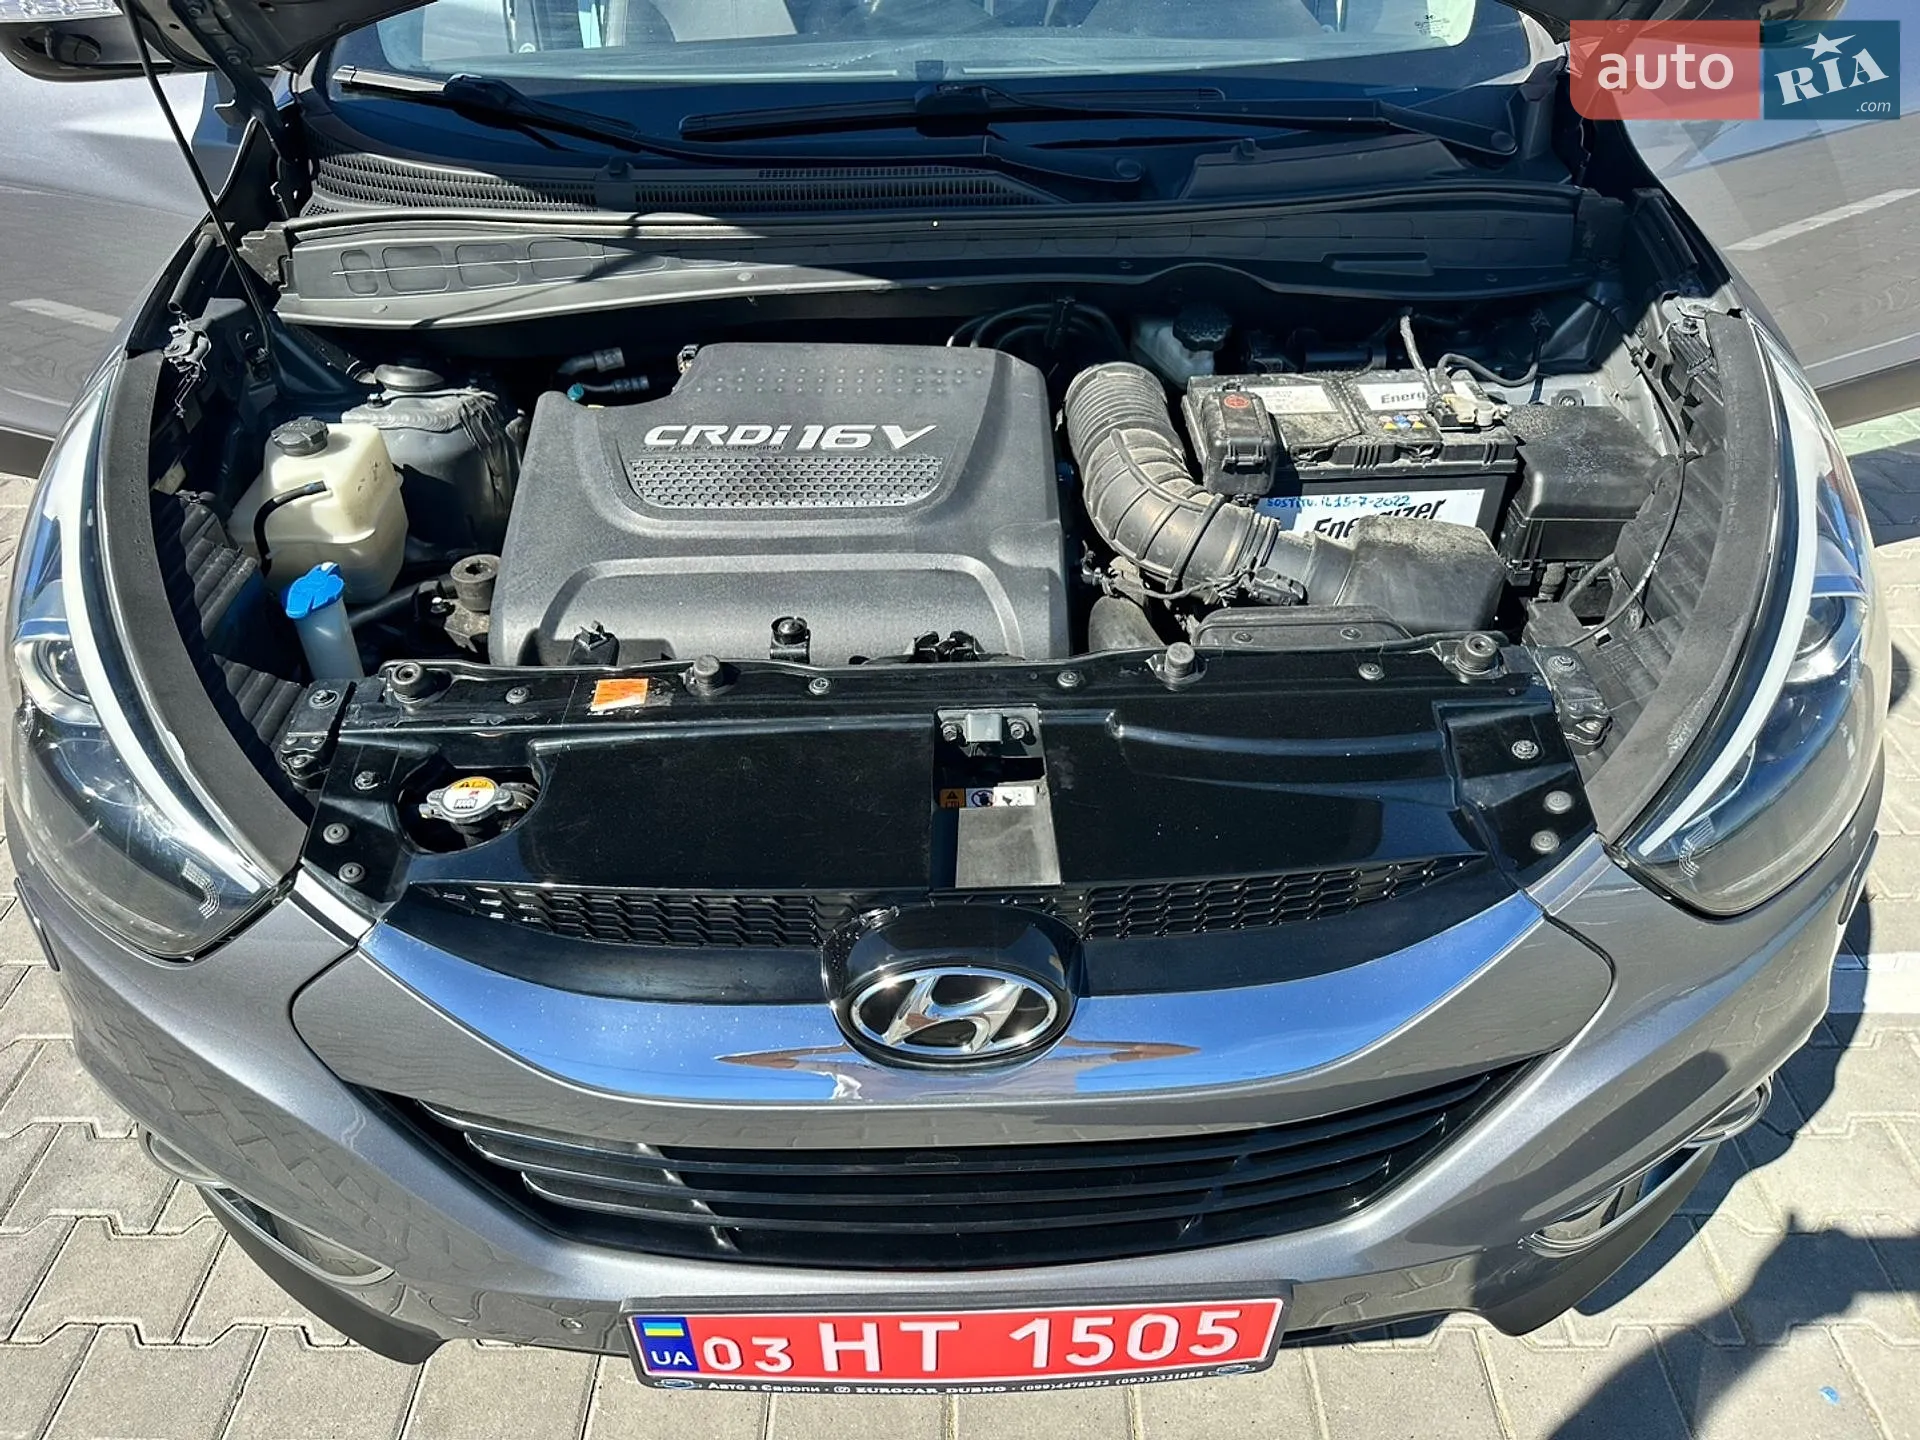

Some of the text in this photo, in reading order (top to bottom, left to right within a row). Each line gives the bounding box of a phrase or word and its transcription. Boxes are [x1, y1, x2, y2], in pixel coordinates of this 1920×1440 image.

[643, 425, 938, 450] CRDi 16V
[702, 1308, 1243, 1373] 03 HT 1505
[651, 1350, 693, 1365] UA
